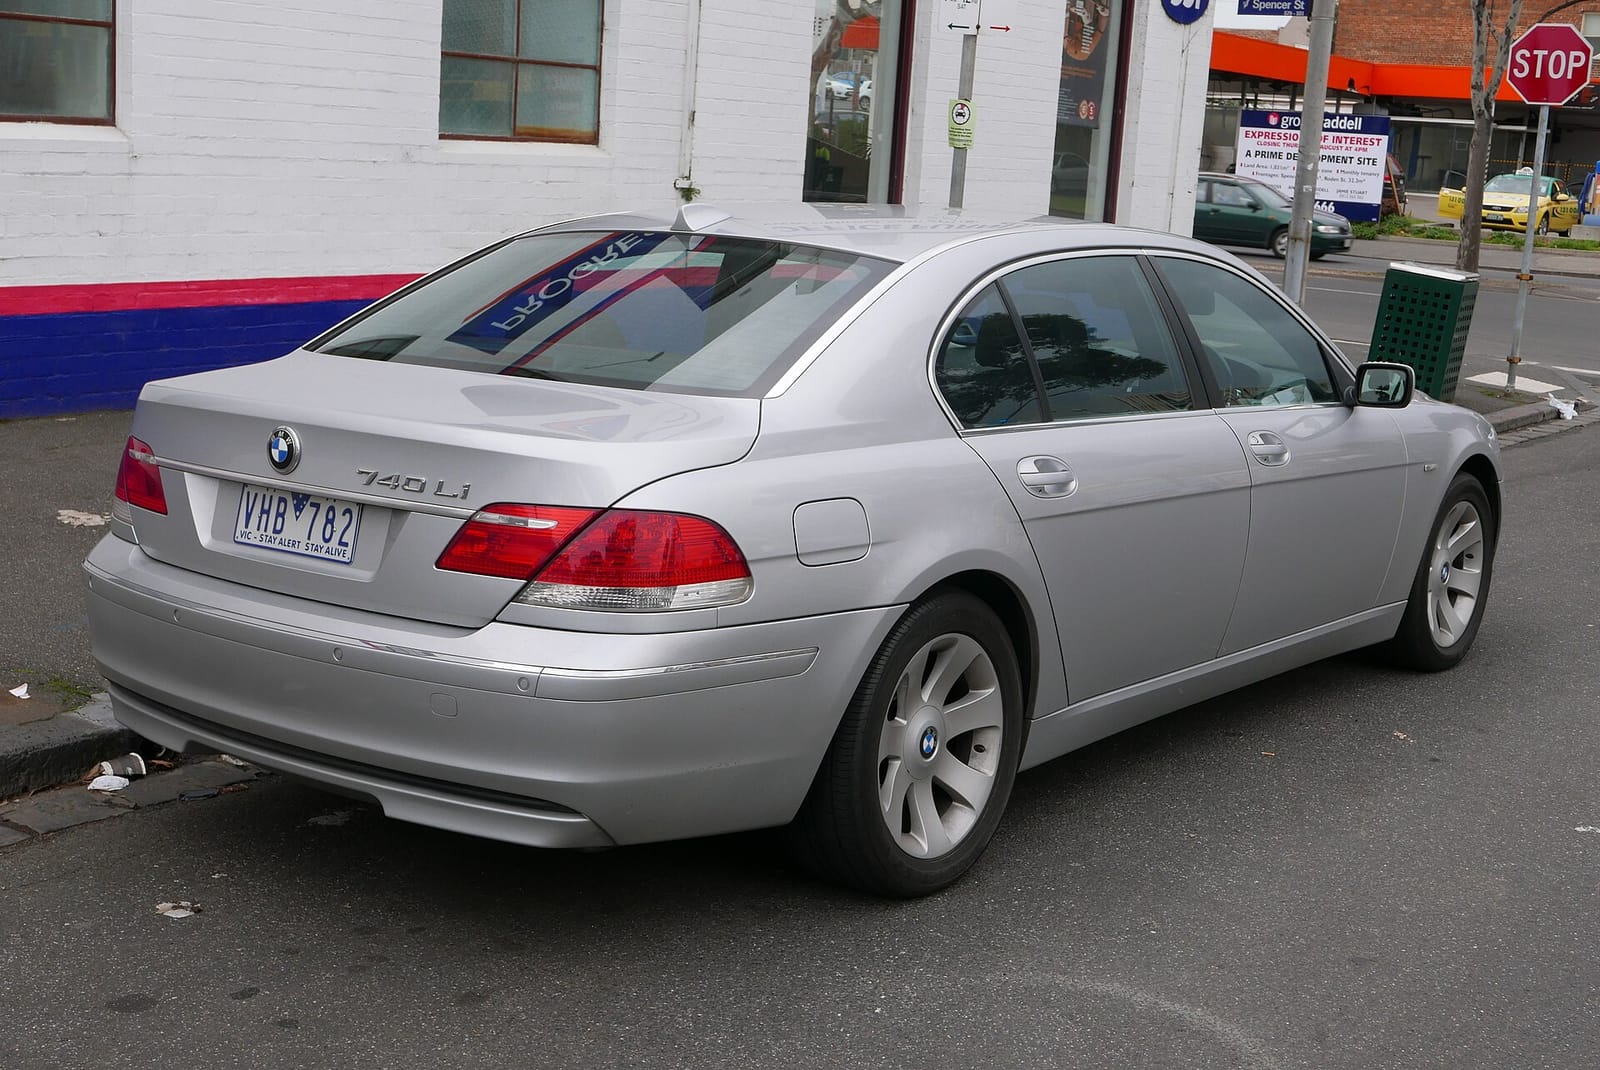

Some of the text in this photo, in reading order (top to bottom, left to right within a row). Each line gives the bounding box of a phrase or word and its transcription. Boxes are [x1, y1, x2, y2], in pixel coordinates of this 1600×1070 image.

[1252, 0, 1305, 11] Spencer St
[1513, 49, 1586, 80] STOP
[1280, 115, 1363, 131] gro addell
[1244, 130, 1299, 141] EXPRESSIO
[1332, 135, 1383, 147] INTEREST
[1245, 149, 1252, 158] A
[1254, 150, 1284, 160] PRIME
[1356, 156, 1378, 166] SITE
[356, 468, 471, 500] 740 Li
[244, 490, 353, 548] VHB 782
[240, 530, 252, 540] VIC
[259, 533, 277, 545] STAY
[277, 537, 301, 550] ALERT
[304, 542, 324, 554] STAY
[324, 545, 347, 558] ALIVE
